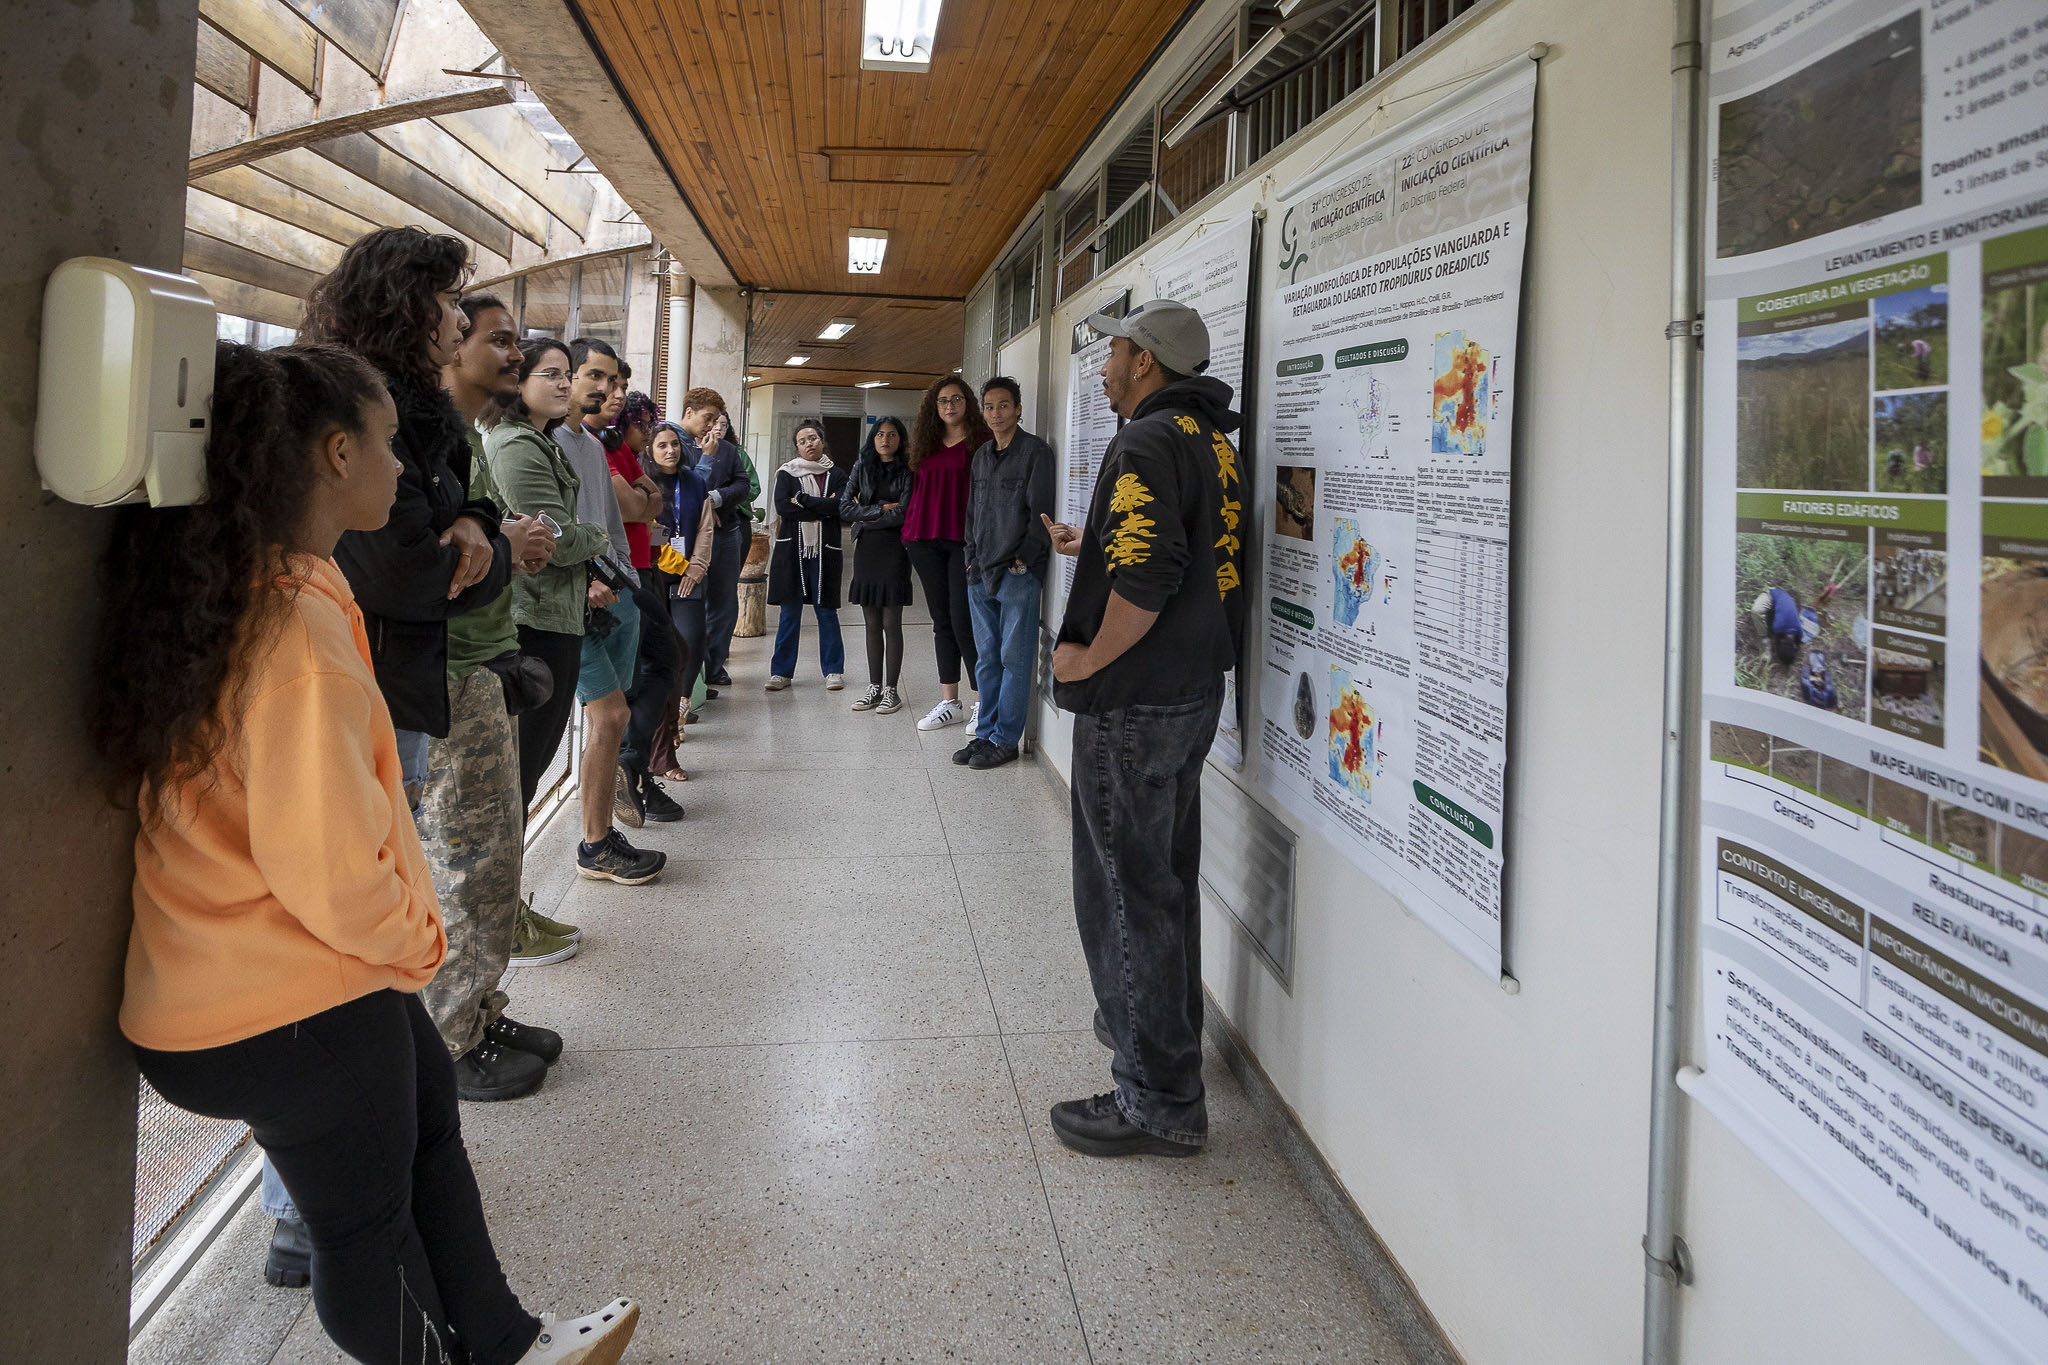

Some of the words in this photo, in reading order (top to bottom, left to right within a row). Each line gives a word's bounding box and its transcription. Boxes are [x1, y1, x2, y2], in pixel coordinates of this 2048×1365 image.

[1321, 179, 1361, 208] CONGRESSO
[1362, 173, 1373, 189] DE
[1401, 160, 1449, 193] INICIAÇÃO
[1451, 137, 1510, 171] CIENTÍFICA
[1931, 146, 1994, 178] Desenho
[1310, 207, 1344, 232] INICIAÇÃO
[1344, 188, 1386, 217] CIENTÍFICA
[1352, 219, 1360, 232] de
[1410, 190, 1437, 209] Distrito
[1283, 285, 1313, 305] VARIAÇÃO
[1312, 269, 1360, 296] MORFOLÓGICA
[1361, 265, 1372, 280] DE
[1373, 246, 1432, 277] POPULAÇÕES
[1433, 224, 1501, 259] VANGUARDA
[1503, 221, 1510, 237] E
[1825, 233, 1926, 272] LEVANTAMENTO
[1929, 230, 1940, 245] E
[1291, 296, 1332, 318] RETAGUARDA
[1332, 292, 1343, 307] DO
[1343, 282, 1378, 303] LAGARTO
[1379, 265, 1433, 293] TROPIDURUS
[1435, 249, 1491, 279] OREADICUS
[1756, 287, 1829, 314] COBERTURA
[1830, 282, 1848, 298] DA
[1849, 263, 1931, 296] VEGETAÇÃO
[1336, 351, 1367, 364] RESULTADOS
[1367, 350, 1372, 359] E
[1372, 343, 1406, 358] DISCUSSÃO
[1783, 500, 1835, 516] FATORES
[1836, 501, 1900, 521] EDÁFICOS
[1429, 794, 1475, 832] CONCLUSÃO
[1870, 750, 1970, 797] MAPEAMENTO
[1971, 787, 2010, 814] COM
[1773, 800, 1816, 830] Cerrado
[1721, 849, 1788, 890] CONTEXTO
[1788, 883, 1797, 896] E
[1798, 885, 1862, 933] URGÊNCIA
[1929, 872, 2028, 934] Restauração
[1723, 879, 1803, 934] Transformações
[1805, 926, 1859, 968] antrópicas
[1752, 916, 1761, 928] x
[1761, 919, 1831, 973] biodiversidade
[1911, 901, 2012, 968] RELEVÂNCIA
[1870, 925, 1968, 995] IMPORTÂNCIA
[1872, 964, 1949, 1027] Restauração
[1951, 1016, 1972, 1041] de
[1974, 1031, 1994, 1055] 12
[1727, 970, 1774, 1013] Serviços
[1775, 1007, 1868, 1084] ecossistêmicos
[1888, 1091, 1970, 1163] diversidade
[1973, 1156, 1997, 1183] da
[1862, 1029, 1955, 1108] RESULTADOS
[1888, 1003, 1906, 1023] de
[1906, 1015, 1964, 1063] hectares
[1966, 1055, 1991, 1080] até
[1993, 1069, 2036, 1109] 2030
[1727, 995, 1752, 1019] ativo
[1753, 1013, 1760, 1025] e
[1760, 1020, 1803, 1060] próximo
[1814, 1061, 1834, 1083] um
[1835, 1075, 1886, 1125] Cerrado
[1887, 1119, 1975, 1199] conservado,
[1979, 1187, 2022, 1231] bem
[1765, 1048, 1773, 1060] e
[1774, 1054, 1858, 1129] disponibilidade
[1858, 1123, 1876, 1145] de
[1725, 1034, 1796, 1105] Transferência
[1797, 1099, 1822, 1126] dos
[1822, 1119, 1893, 1187] resultados
[1896, 1182, 1930, 1220] para
[1933, 1212, 2012, 1288] usuários
